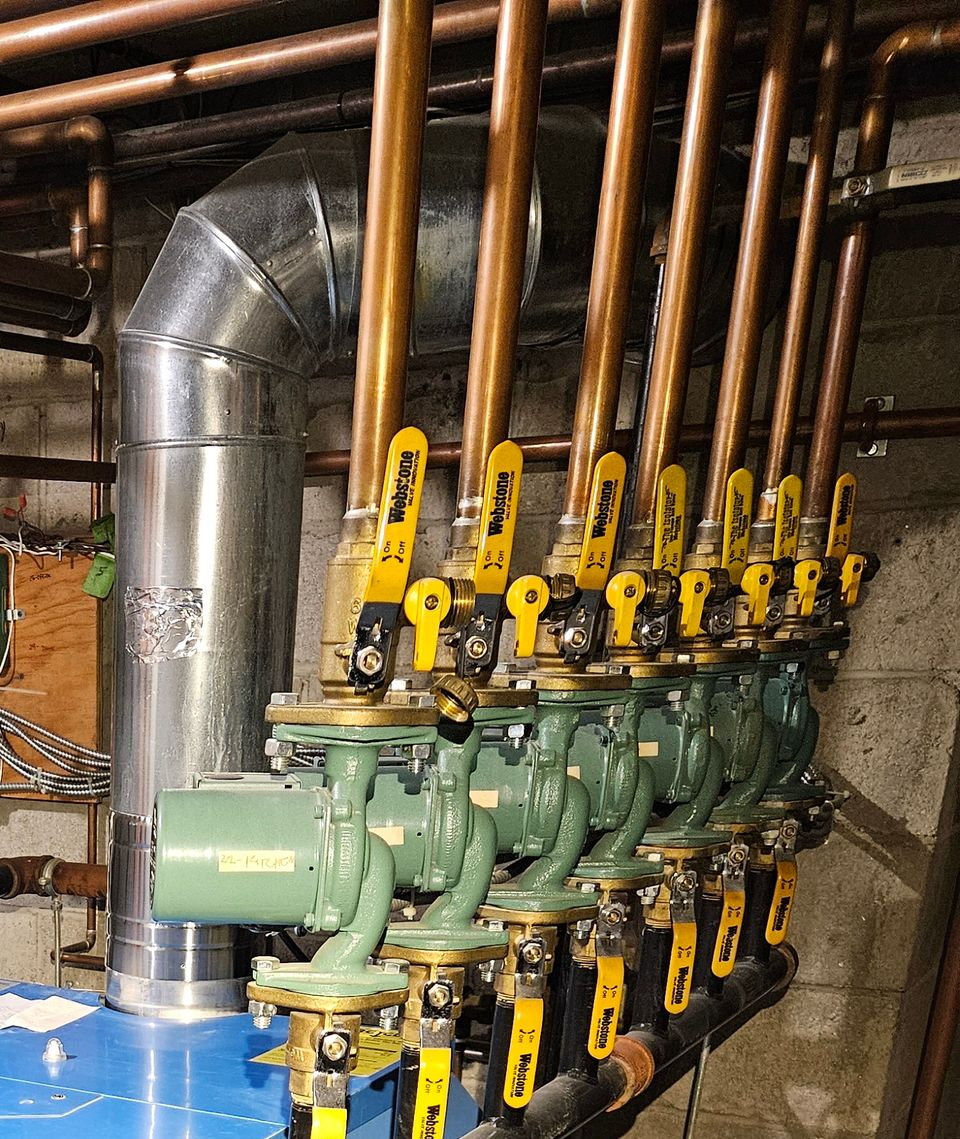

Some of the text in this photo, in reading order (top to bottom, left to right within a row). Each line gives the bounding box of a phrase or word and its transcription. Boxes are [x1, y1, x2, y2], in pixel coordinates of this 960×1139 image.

[387, 450, 415, 525] Webstone
[488, 471, 509, 537] Webstone
[591, 480, 613, 539] Webstone
[674, 966, 690, 1005] Webstone
[597, 1007, 615, 1049] Webstone
[514, 1053, 532, 1098] Webstone
